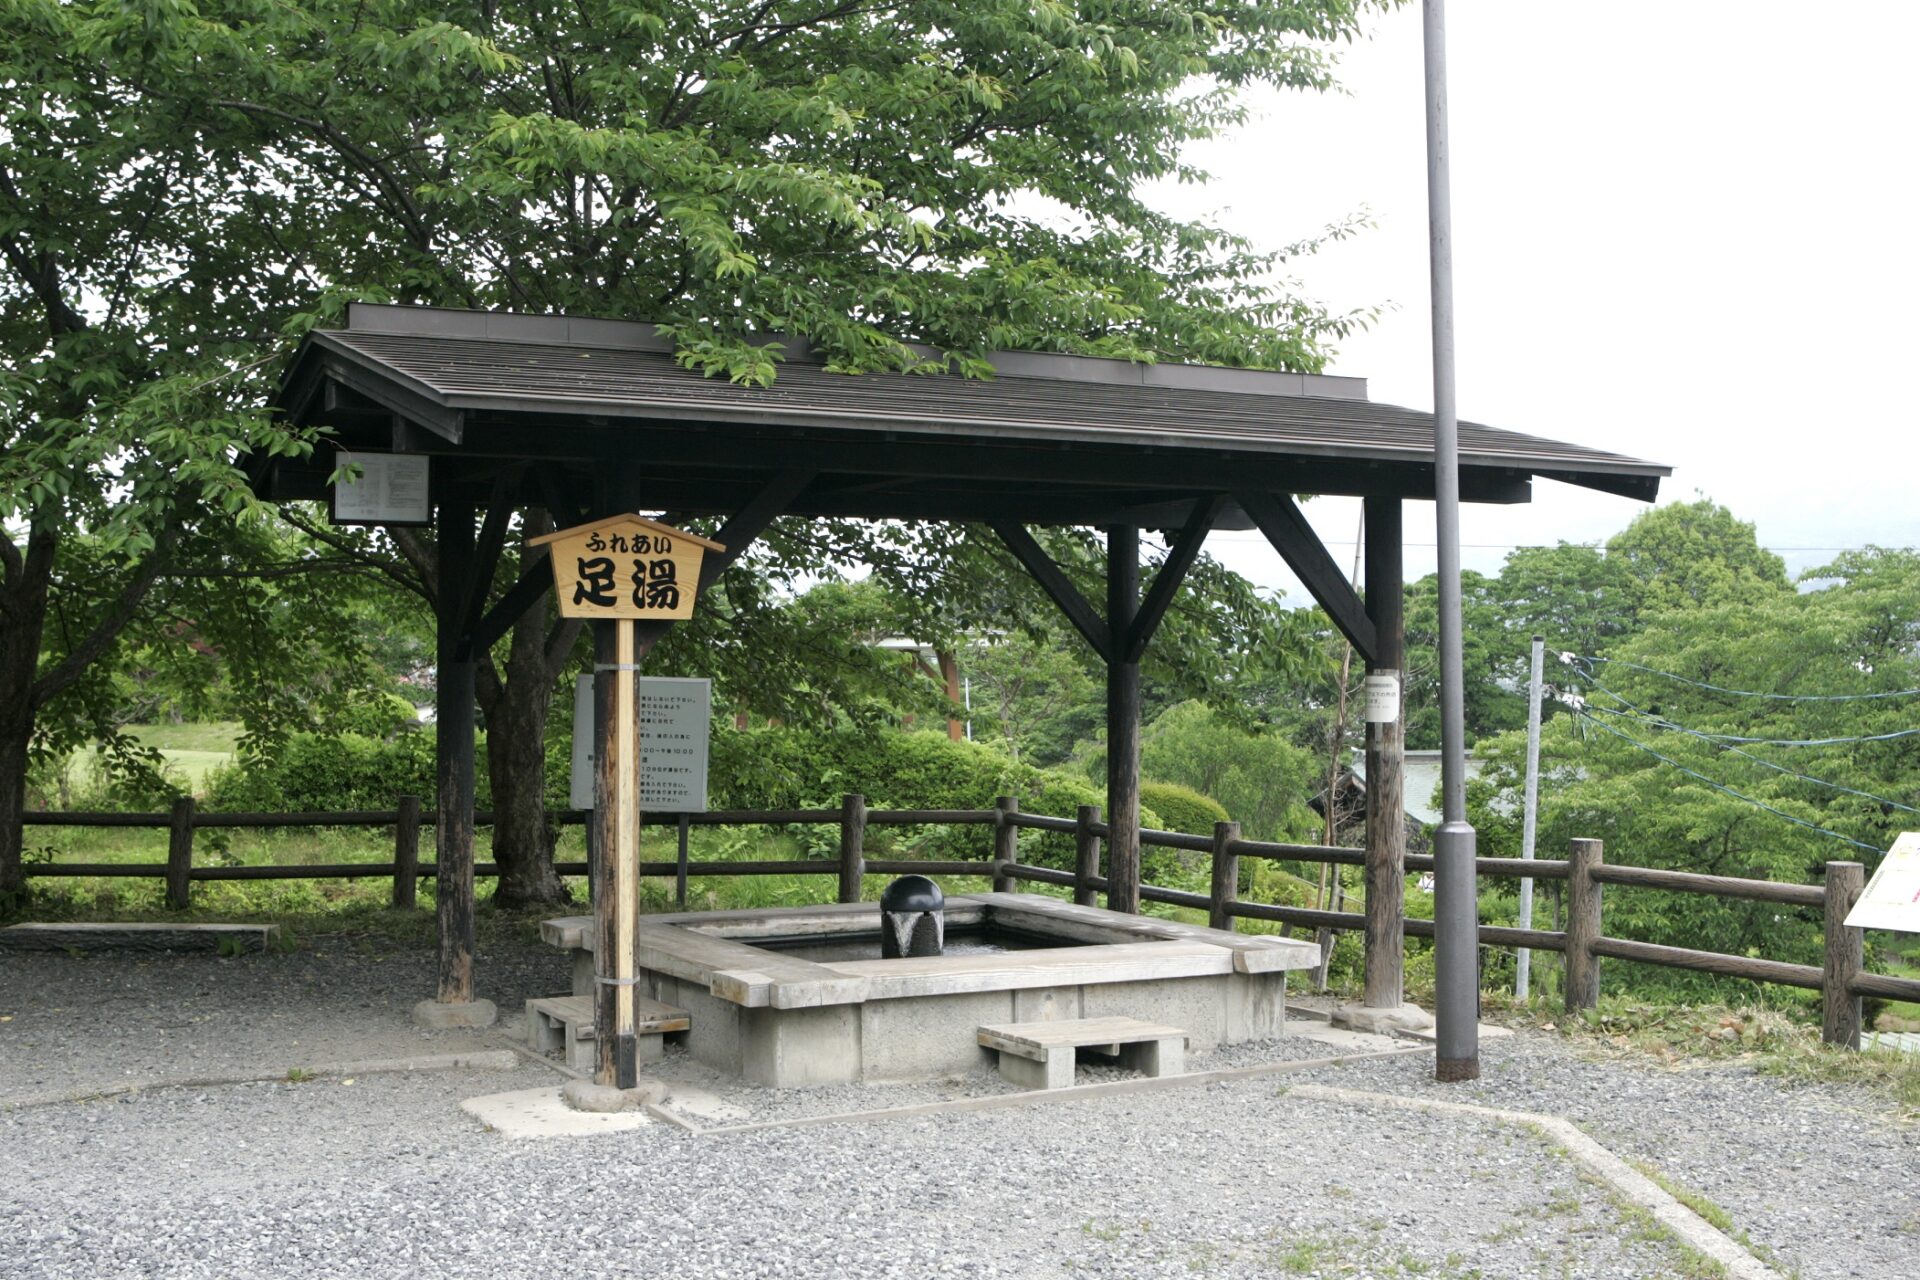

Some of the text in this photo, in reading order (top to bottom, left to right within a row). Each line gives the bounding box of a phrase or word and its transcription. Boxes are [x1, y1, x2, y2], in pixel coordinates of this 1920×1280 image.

[585, 532, 672, 554] ふれあい
[573, 557, 680, 610] 足湯
